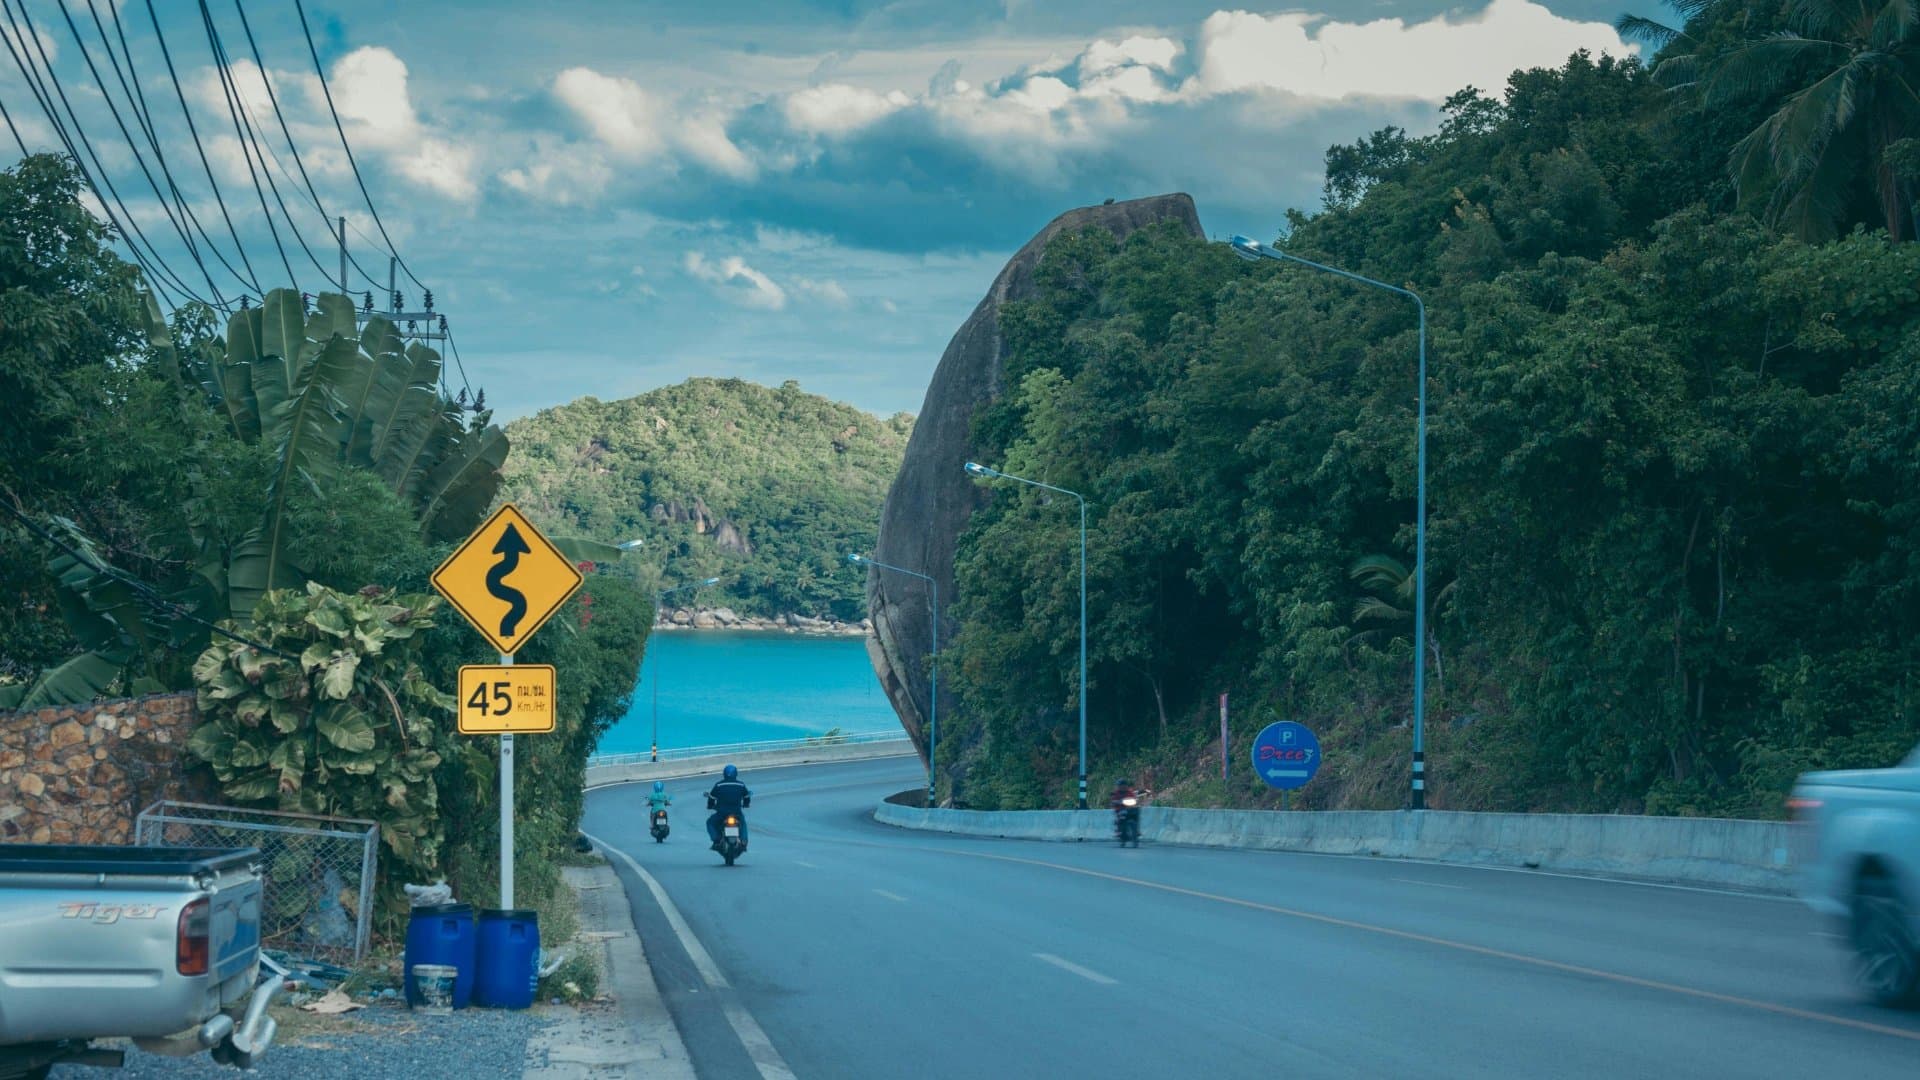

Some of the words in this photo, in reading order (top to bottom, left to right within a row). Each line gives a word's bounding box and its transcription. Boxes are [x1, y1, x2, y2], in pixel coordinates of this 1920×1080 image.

[467, 682, 512, 716] 45
[1282, 731, 1292, 743] P
[58, 902, 168, 925] Tiger
